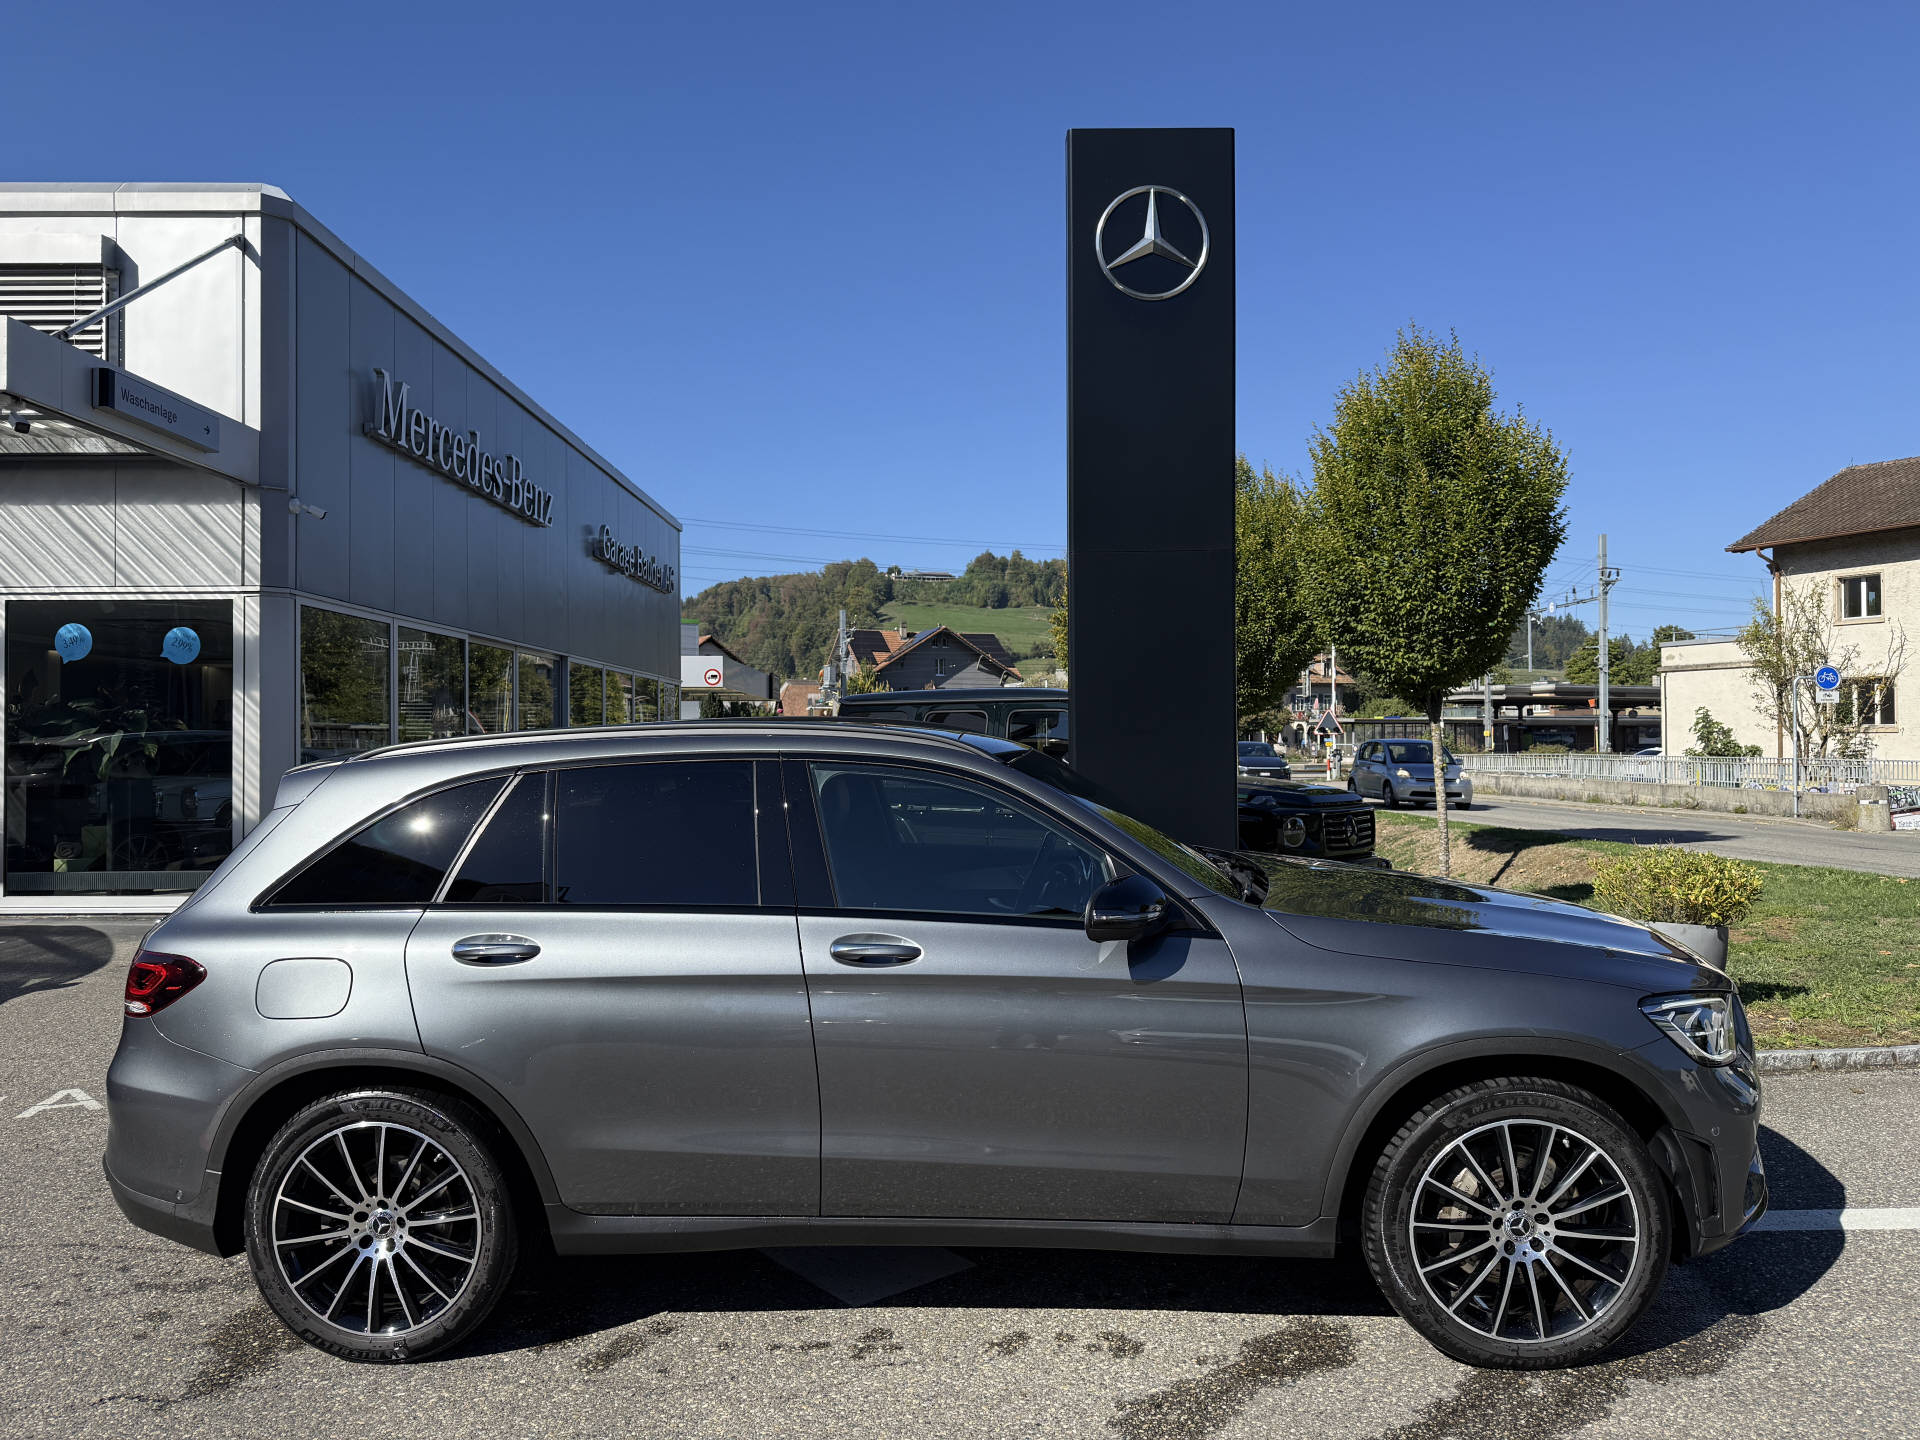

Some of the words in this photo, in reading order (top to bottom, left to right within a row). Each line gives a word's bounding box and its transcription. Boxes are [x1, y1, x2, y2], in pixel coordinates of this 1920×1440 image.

[120, 386, 178, 424] Waschanlage
[375, 368, 554, 528] Mercedes-Benz
[602, 525, 636, 576] Garage
